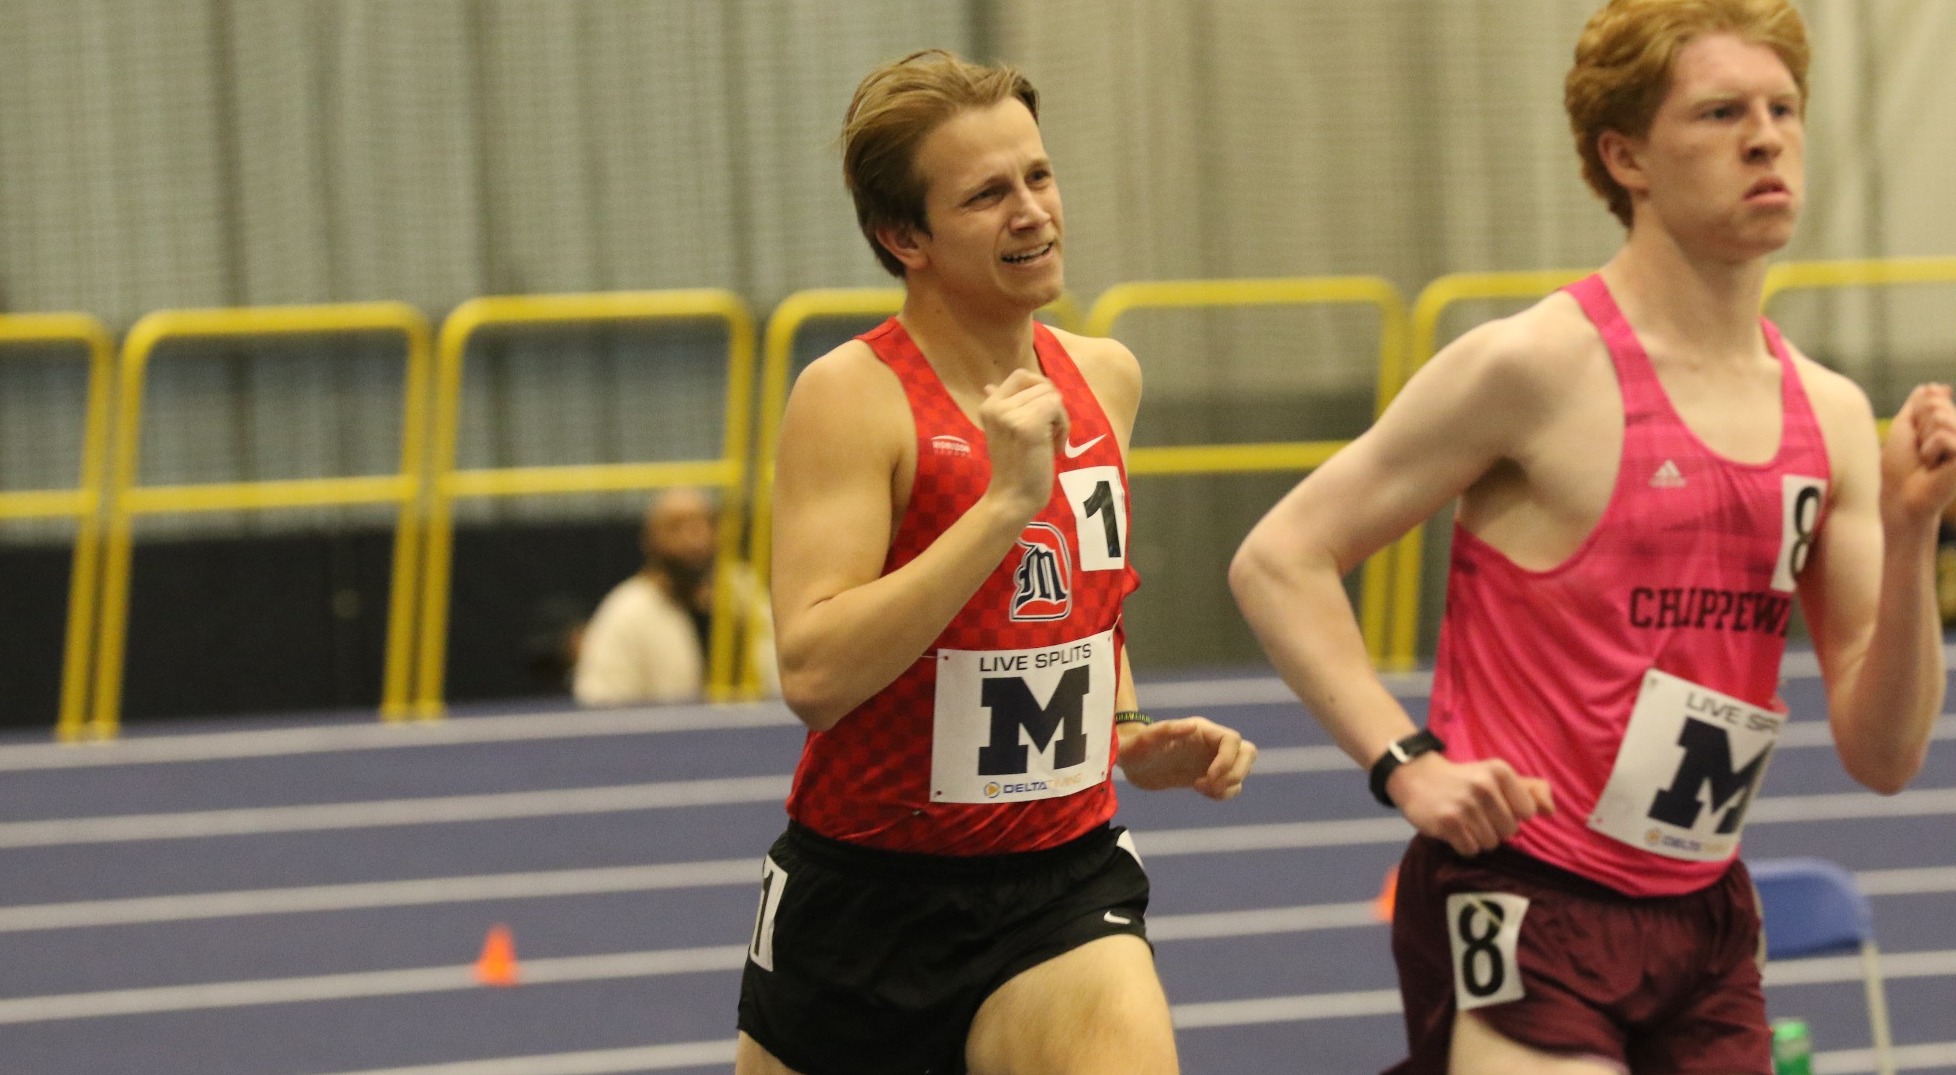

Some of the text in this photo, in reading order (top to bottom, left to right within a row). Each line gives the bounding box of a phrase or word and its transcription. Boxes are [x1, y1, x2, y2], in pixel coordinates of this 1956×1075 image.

[1083, 480, 1122, 558] 1
[1790, 485, 1820, 582] 8
[979, 643, 1092, 672] LIVE SPLITS
[978, 664, 1089, 775] M
[1685, 691, 1742, 725] LIVE
[1647, 716, 1776, 834] M
[753, 869, 774, 957] 1
[1458, 900, 1505, 998] 8
